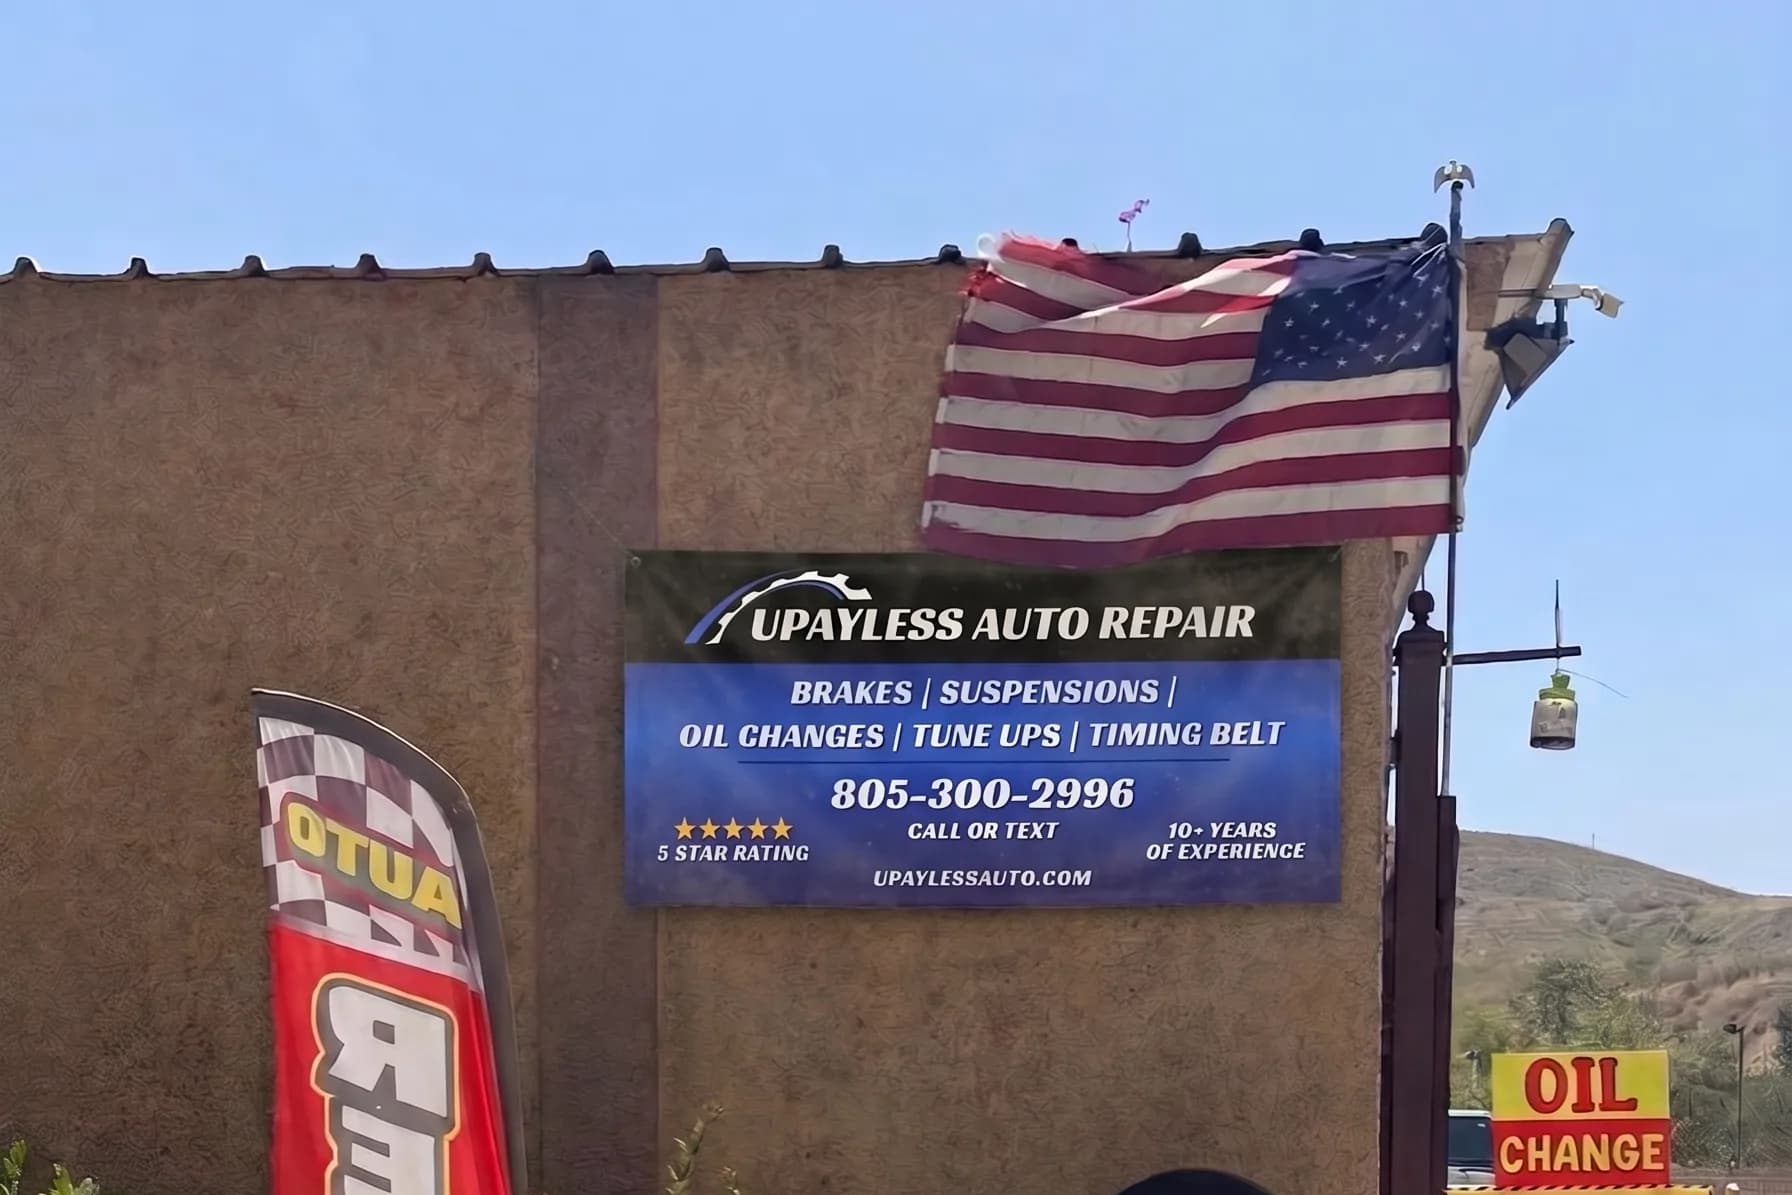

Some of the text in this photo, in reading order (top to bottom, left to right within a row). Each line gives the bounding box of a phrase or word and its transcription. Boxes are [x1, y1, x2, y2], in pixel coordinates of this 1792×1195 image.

[749, 605, 1257, 642] UPAYLESS AUTO REPAIR
[790, 679, 913, 706] BRAKES
[939, 678, 1160, 705] SUSPENSIONS
[679, 724, 729, 749] OIL
[738, 723, 885, 749] CHANGES
[913, 723, 993, 748] TUNE
[999, 722, 1062, 748] UPS
[1089, 721, 1203, 747] TIMING
[1209, 720, 1287, 746] BELT
[830, 778, 1136, 810] 805-300-2996
[907, 821, 1061, 841] CALL OR TEXT
[1168, 821, 1278, 840] 10+ YEARS
[657, 843, 811, 863] 5 STAR RATING
[1146, 842, 1307, 861] OF EXPERIENCE
[872, 869, 1093, 888] UPAYLESSAUTO.COM
[1524, 1056, 1639, 1114] OIL
[1499, 1133, 1665, 1174] CHANGE
